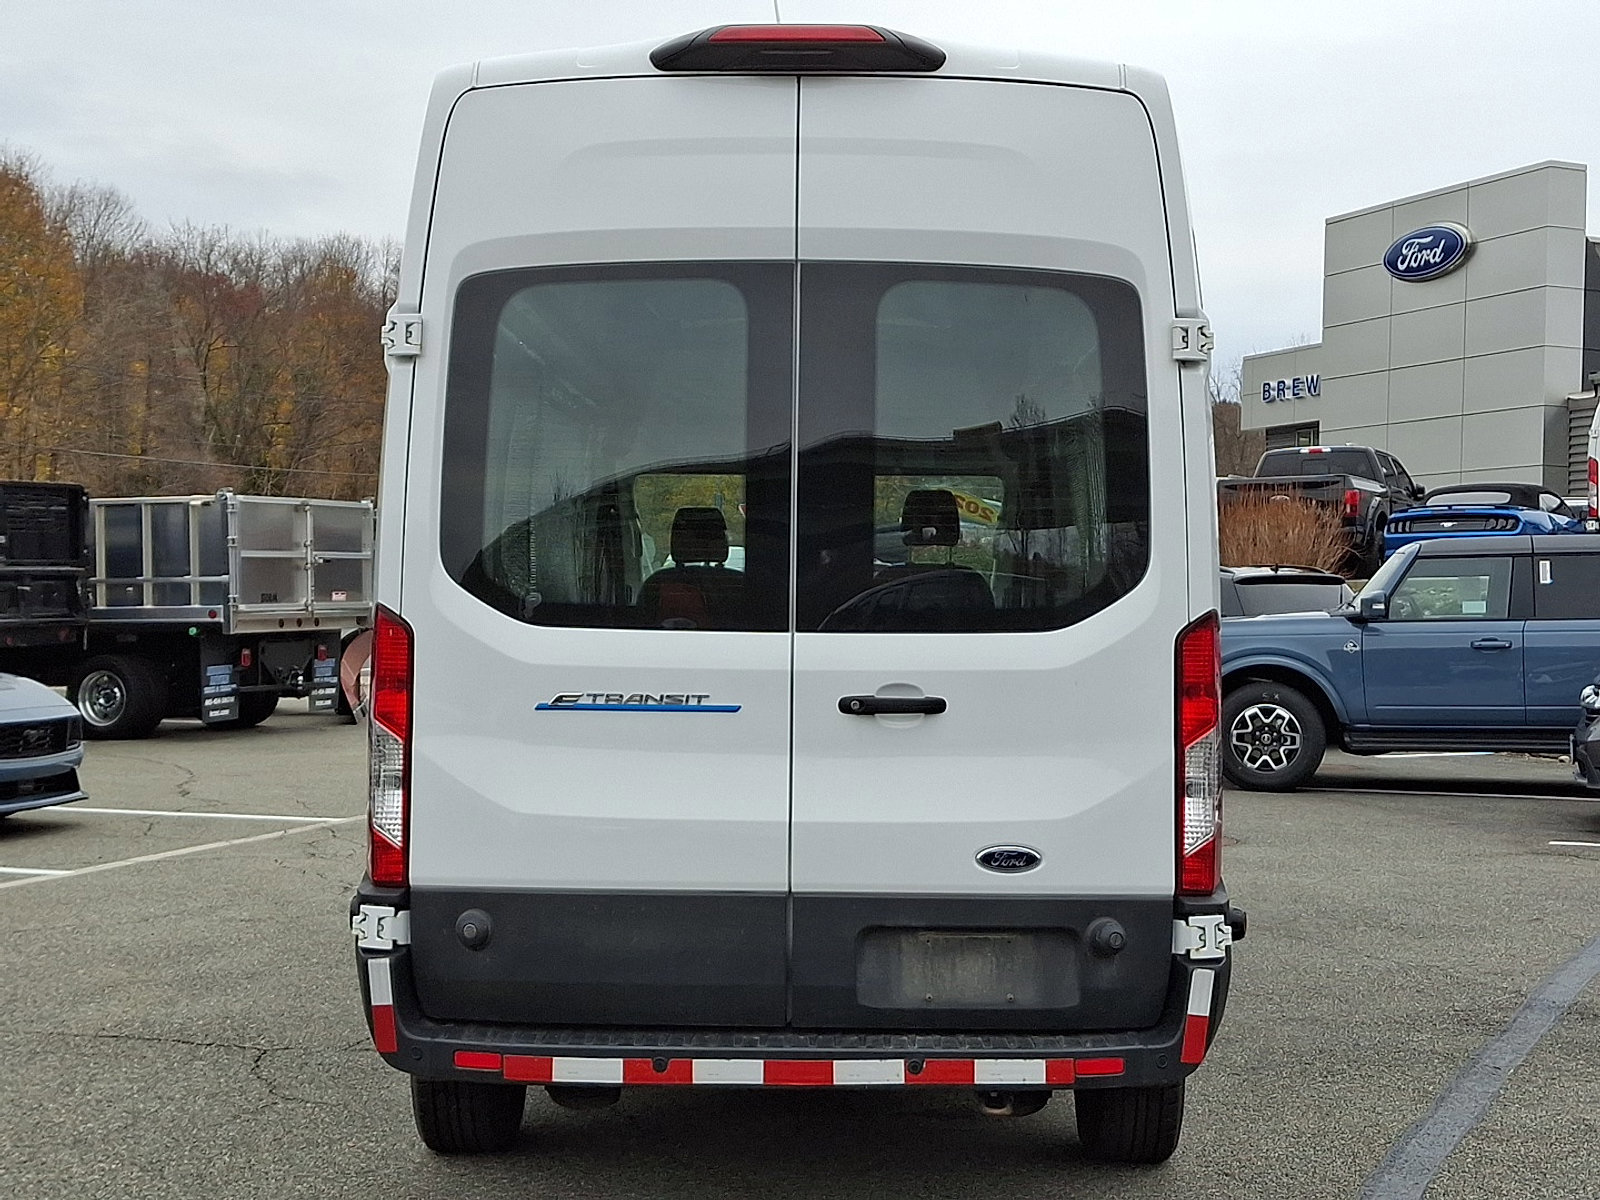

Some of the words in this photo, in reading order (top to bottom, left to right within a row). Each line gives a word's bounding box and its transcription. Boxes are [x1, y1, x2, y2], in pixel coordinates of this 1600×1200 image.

[1397, 235, 1446, 271] Ford
[1262, 374, 1321, 402] BREW
[990, 851, 1028, 867] Ford
